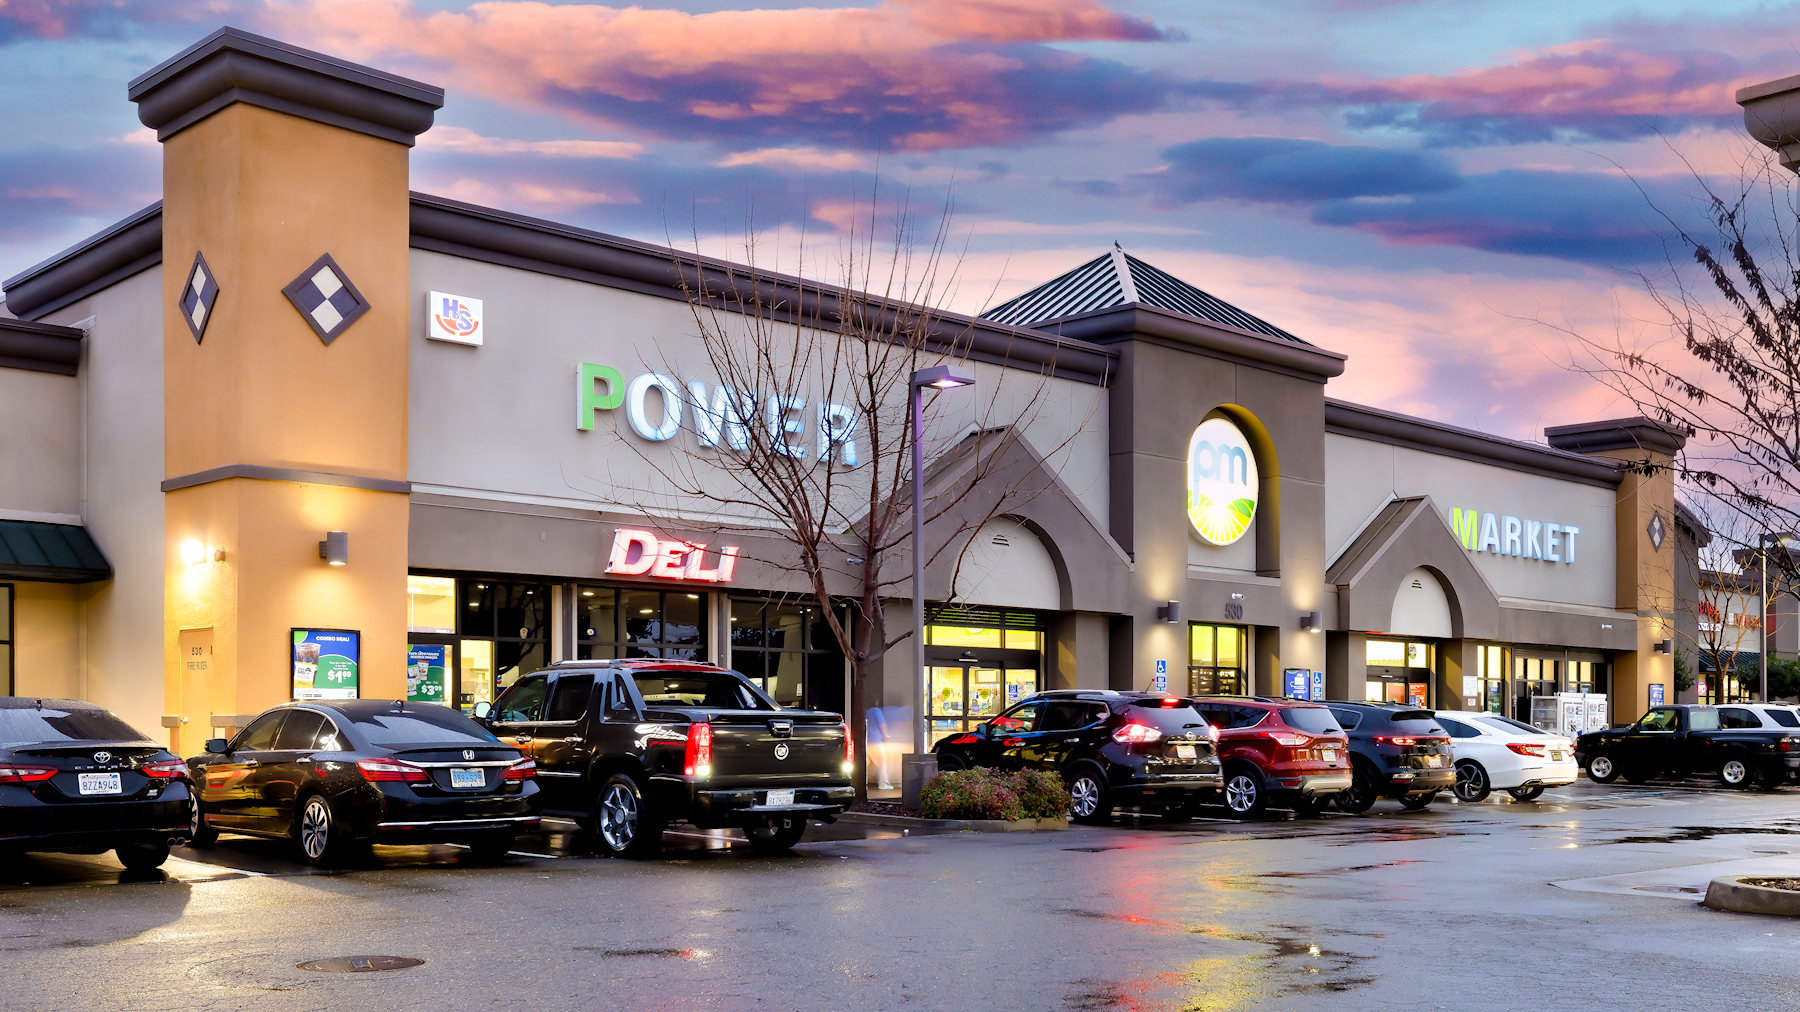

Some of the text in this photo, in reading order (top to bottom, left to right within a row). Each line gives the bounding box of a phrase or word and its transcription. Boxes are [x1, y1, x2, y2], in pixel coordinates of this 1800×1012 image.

[577, 362, 858, 466] POWER
[1193, 440, 1247, 507] pm
[1449, 507, 1580, 564] MARKET
[1225, 603, 1243, 620] 530
[192, 646, 202, 656] 530
[187, 660, 208, 670] FIRE RISER
[82, 780, 118, 790] 8ZZA948
